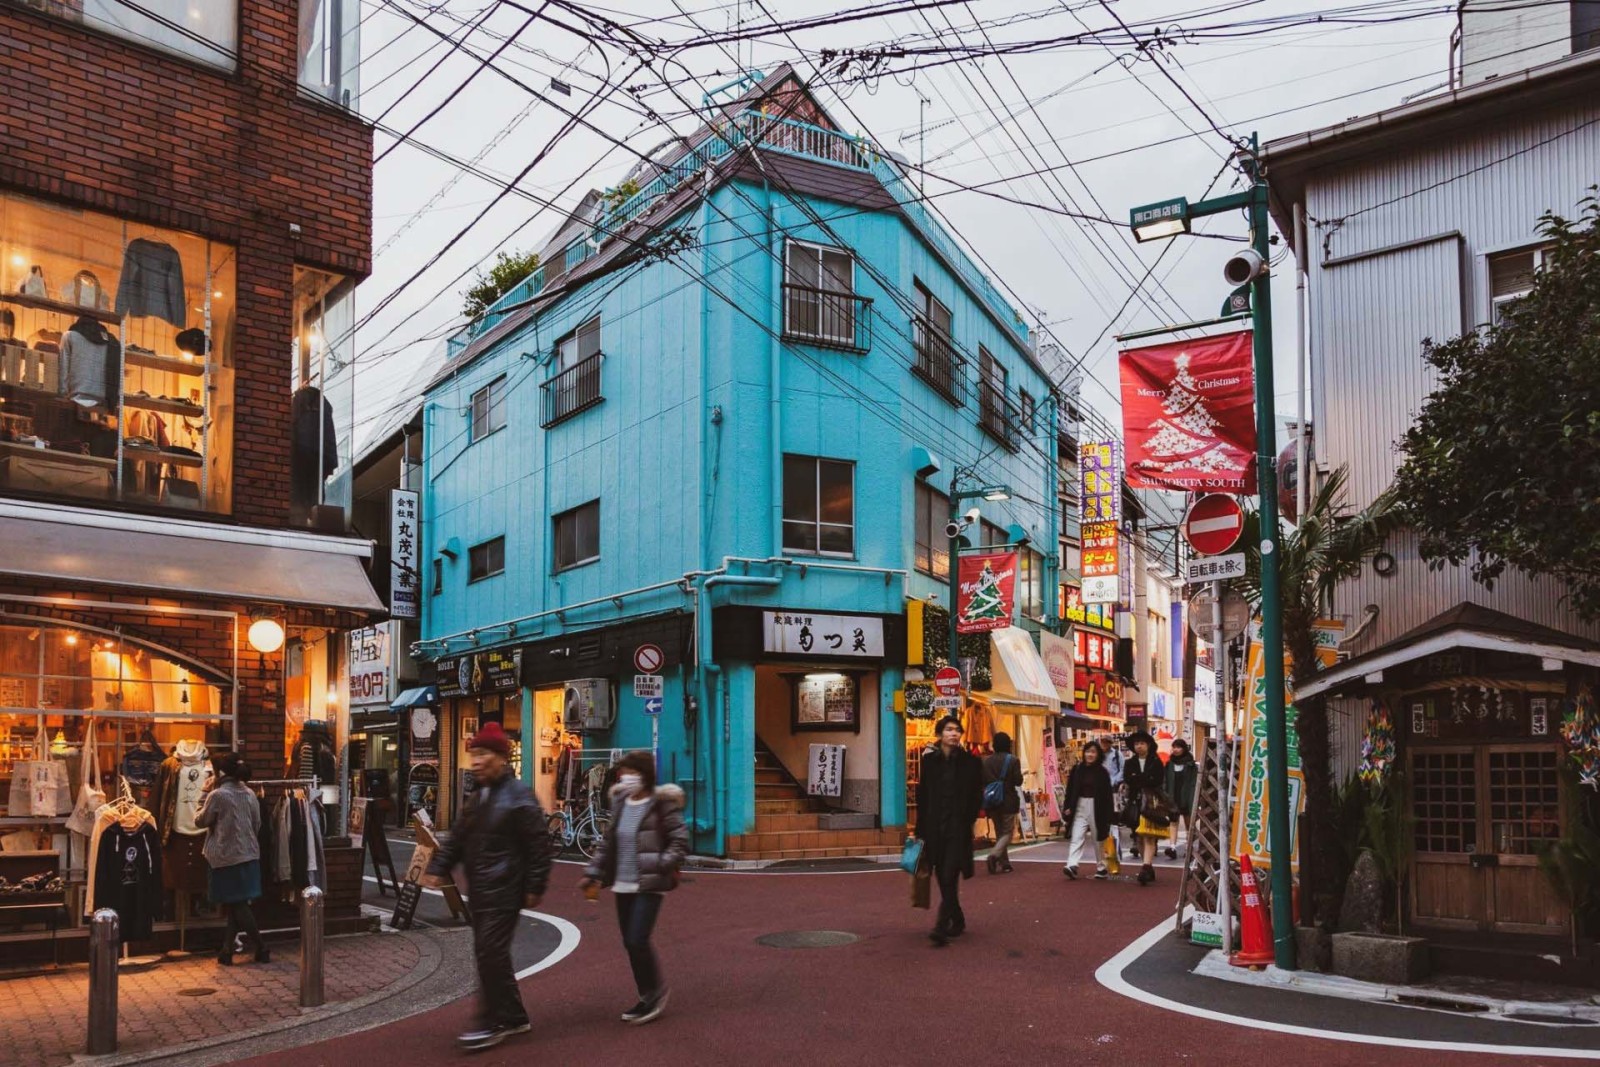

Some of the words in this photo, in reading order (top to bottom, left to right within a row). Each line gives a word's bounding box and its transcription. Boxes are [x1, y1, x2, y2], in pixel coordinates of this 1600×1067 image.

[1134, 203, 1181, 223] 南口商店街
[1137, 388, 1166, 397] Merry
[1198, 376, 1240, 390] Christmas
[1140, 477, 1203, 487] SHIMOKITA
[1206, 479, 1245, 488] SOUTH
[1085, 551, 1115, 564] ゲーム
[1189, 559, 1242, 578] 自転車を除く
[774, 616, 813, 626] 家庭料理
